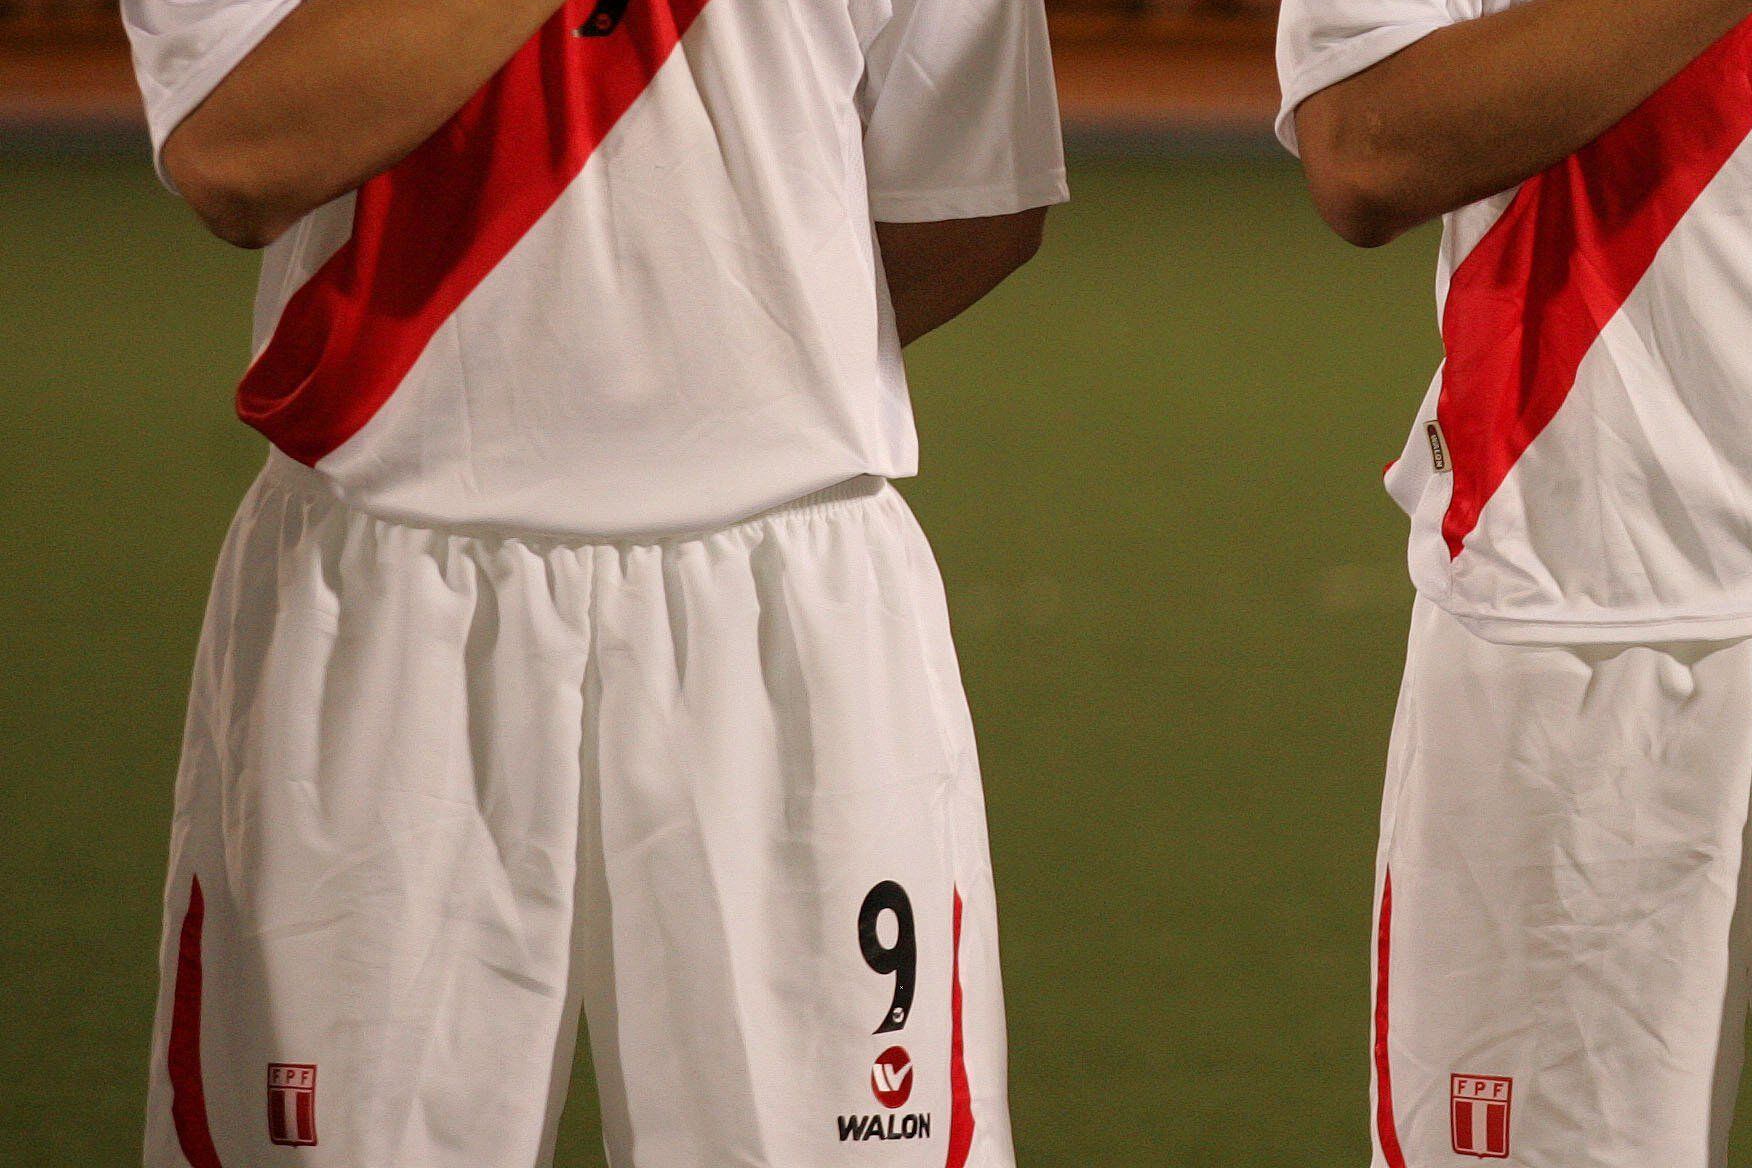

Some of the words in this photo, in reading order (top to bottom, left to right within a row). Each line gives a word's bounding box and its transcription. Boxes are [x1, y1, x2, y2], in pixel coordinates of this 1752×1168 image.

[857, 879, 918, 1036] 9
[272, 1068, 310, 1085] FPF
[1458, 1079, 1505, 1098] FPF
[837, 1112, 931, 1142] WALON
